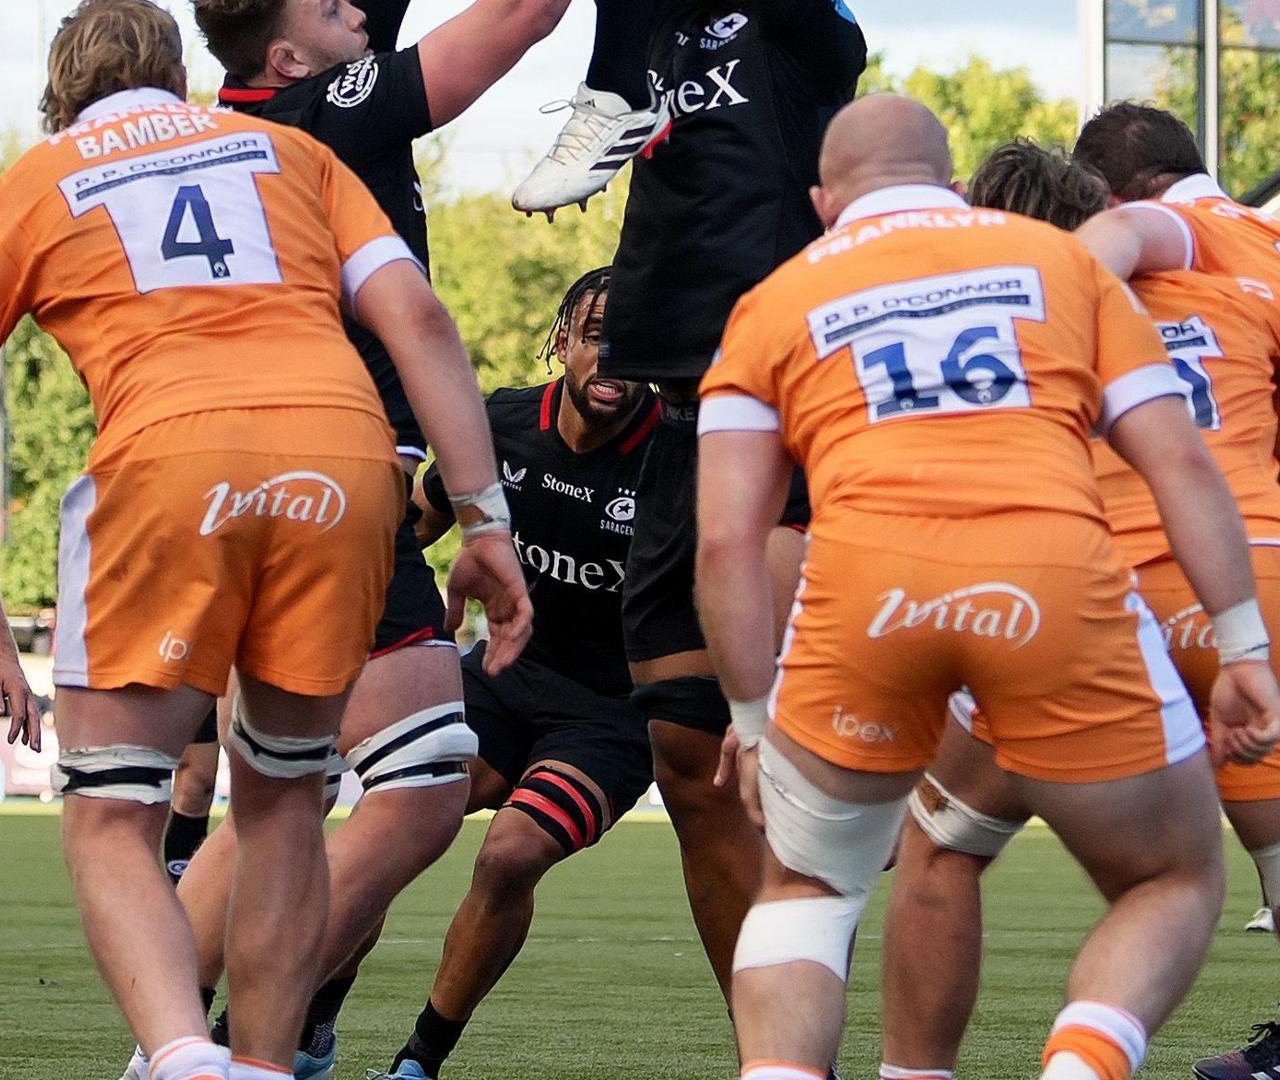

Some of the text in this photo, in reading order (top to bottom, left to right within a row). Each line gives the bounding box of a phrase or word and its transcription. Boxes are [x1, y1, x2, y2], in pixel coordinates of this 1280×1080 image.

[75, 113, 219, 161] BAMBER
[129, 139, 259, 174] O'CONNOR
[160, 183, 235, 280] 4
[882, 279, 1023, 309] O'CONNOR
[862, 326, 1019, 420] 16
[541, 472, 595, 503] StoneX
[599, 519, 635, 537] SARACEN
[831, 704, 894, 742] ipex
